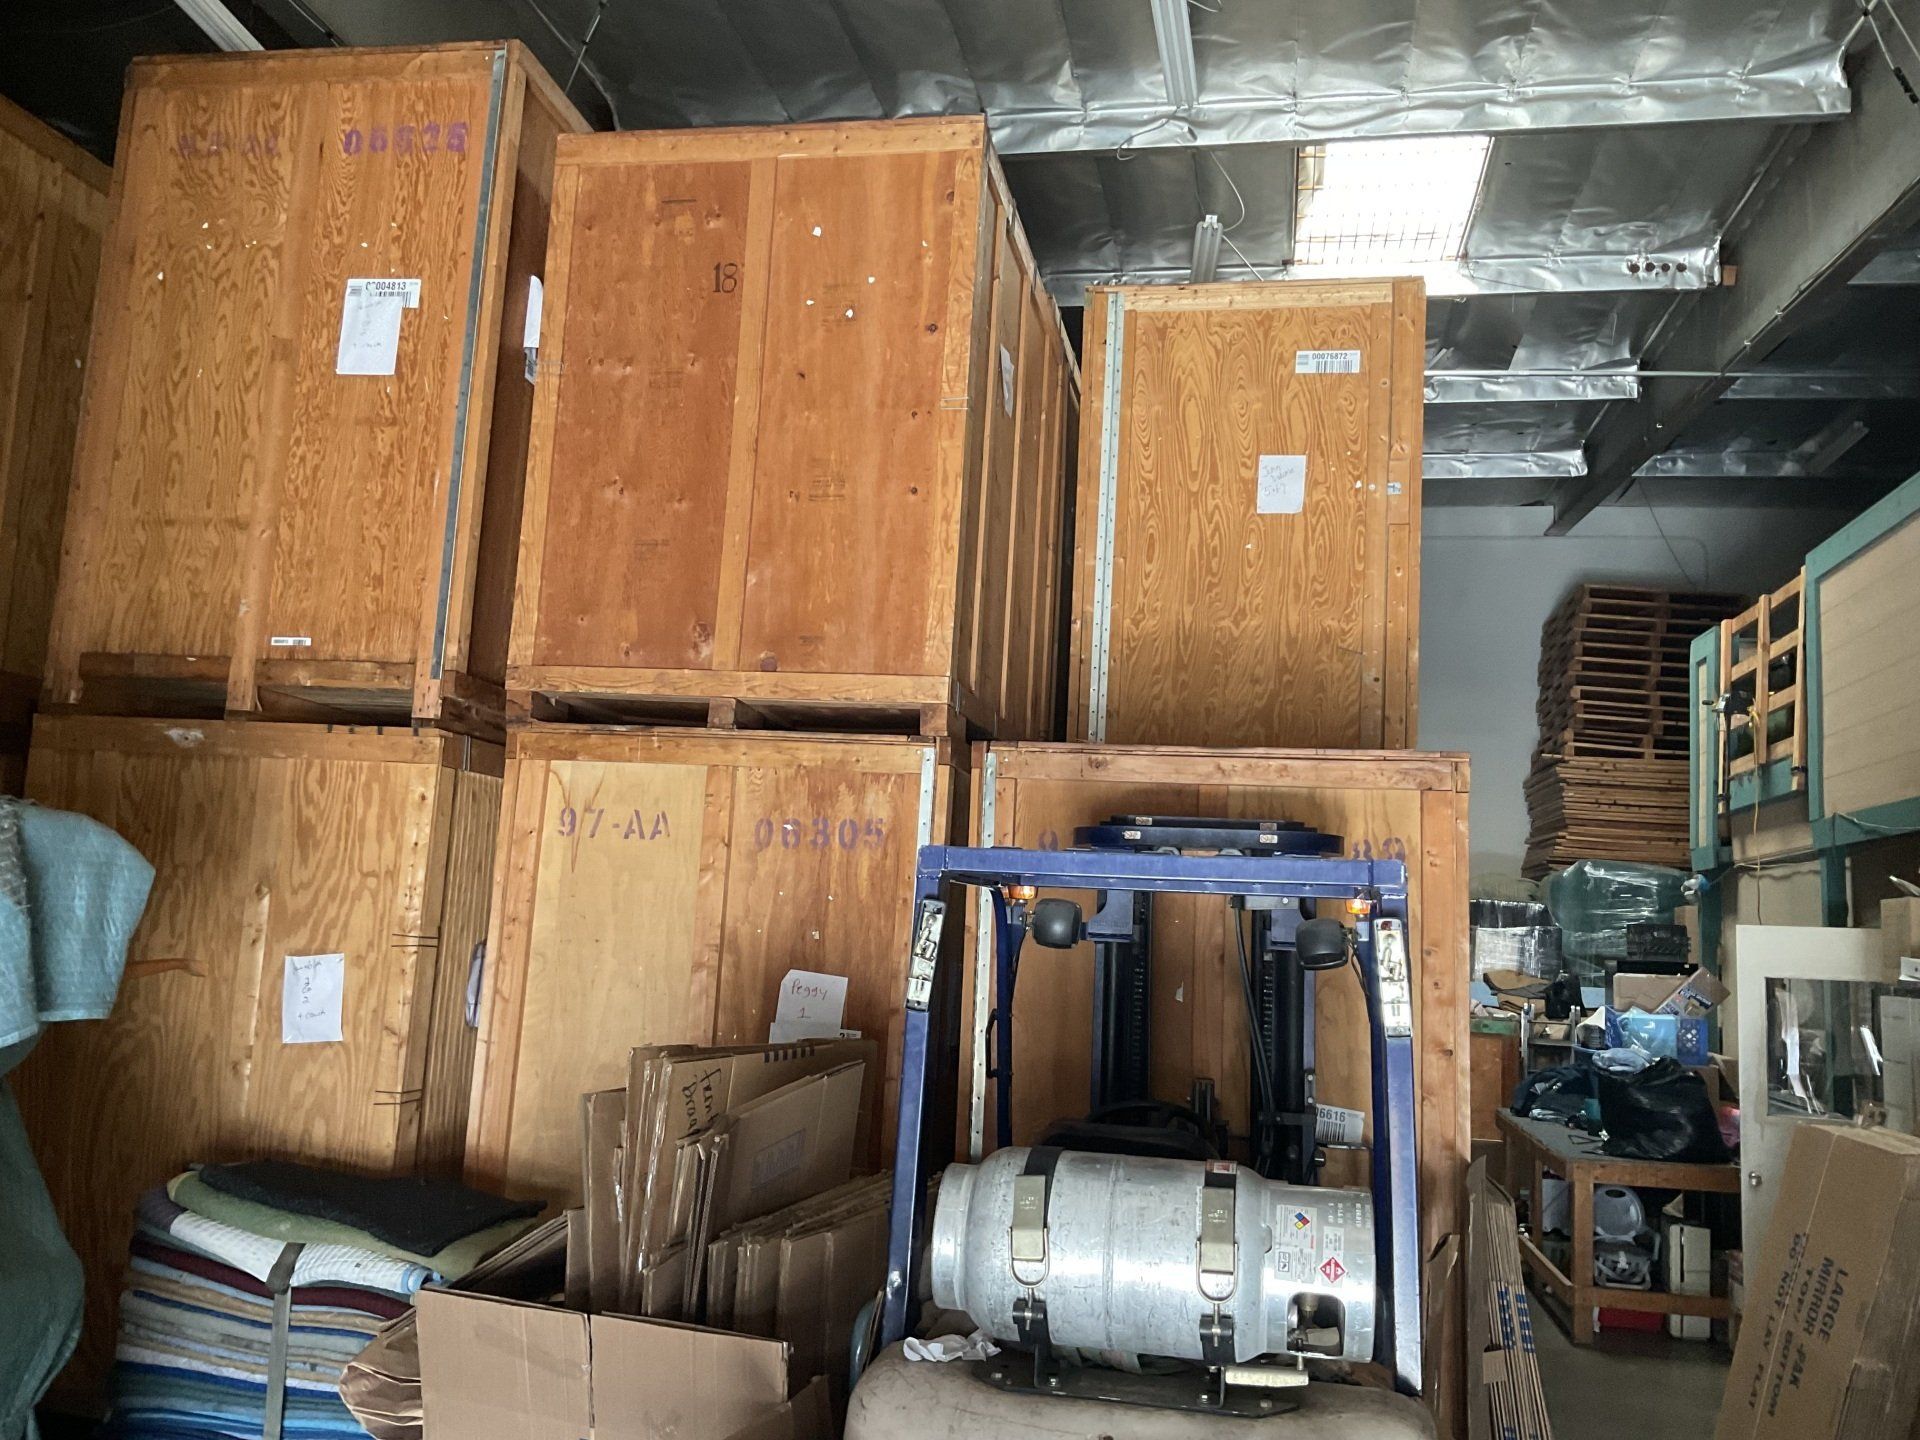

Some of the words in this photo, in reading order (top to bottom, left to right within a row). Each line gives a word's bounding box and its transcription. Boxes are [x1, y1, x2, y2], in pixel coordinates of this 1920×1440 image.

[366, 281, 407, 291] 0004813
[712, 261, 739, 294] 18
[557, 806, 671, 841] 97-AA
[754, 817, 885, 850] 06305
[791, 978, 828, 1001] Peggy
[1316, 1107, 1346, 1123] 6616
[1774, 1270, 1790, 1310] NOT
[1803, 1256, 1835, 1337] MIRROR
[1818, 1267, 1849, 1344] LARGE
[1749, 1362, 1765, 1409] FLAT
[1768, 1329, 1794, 1417] BOTTOM
